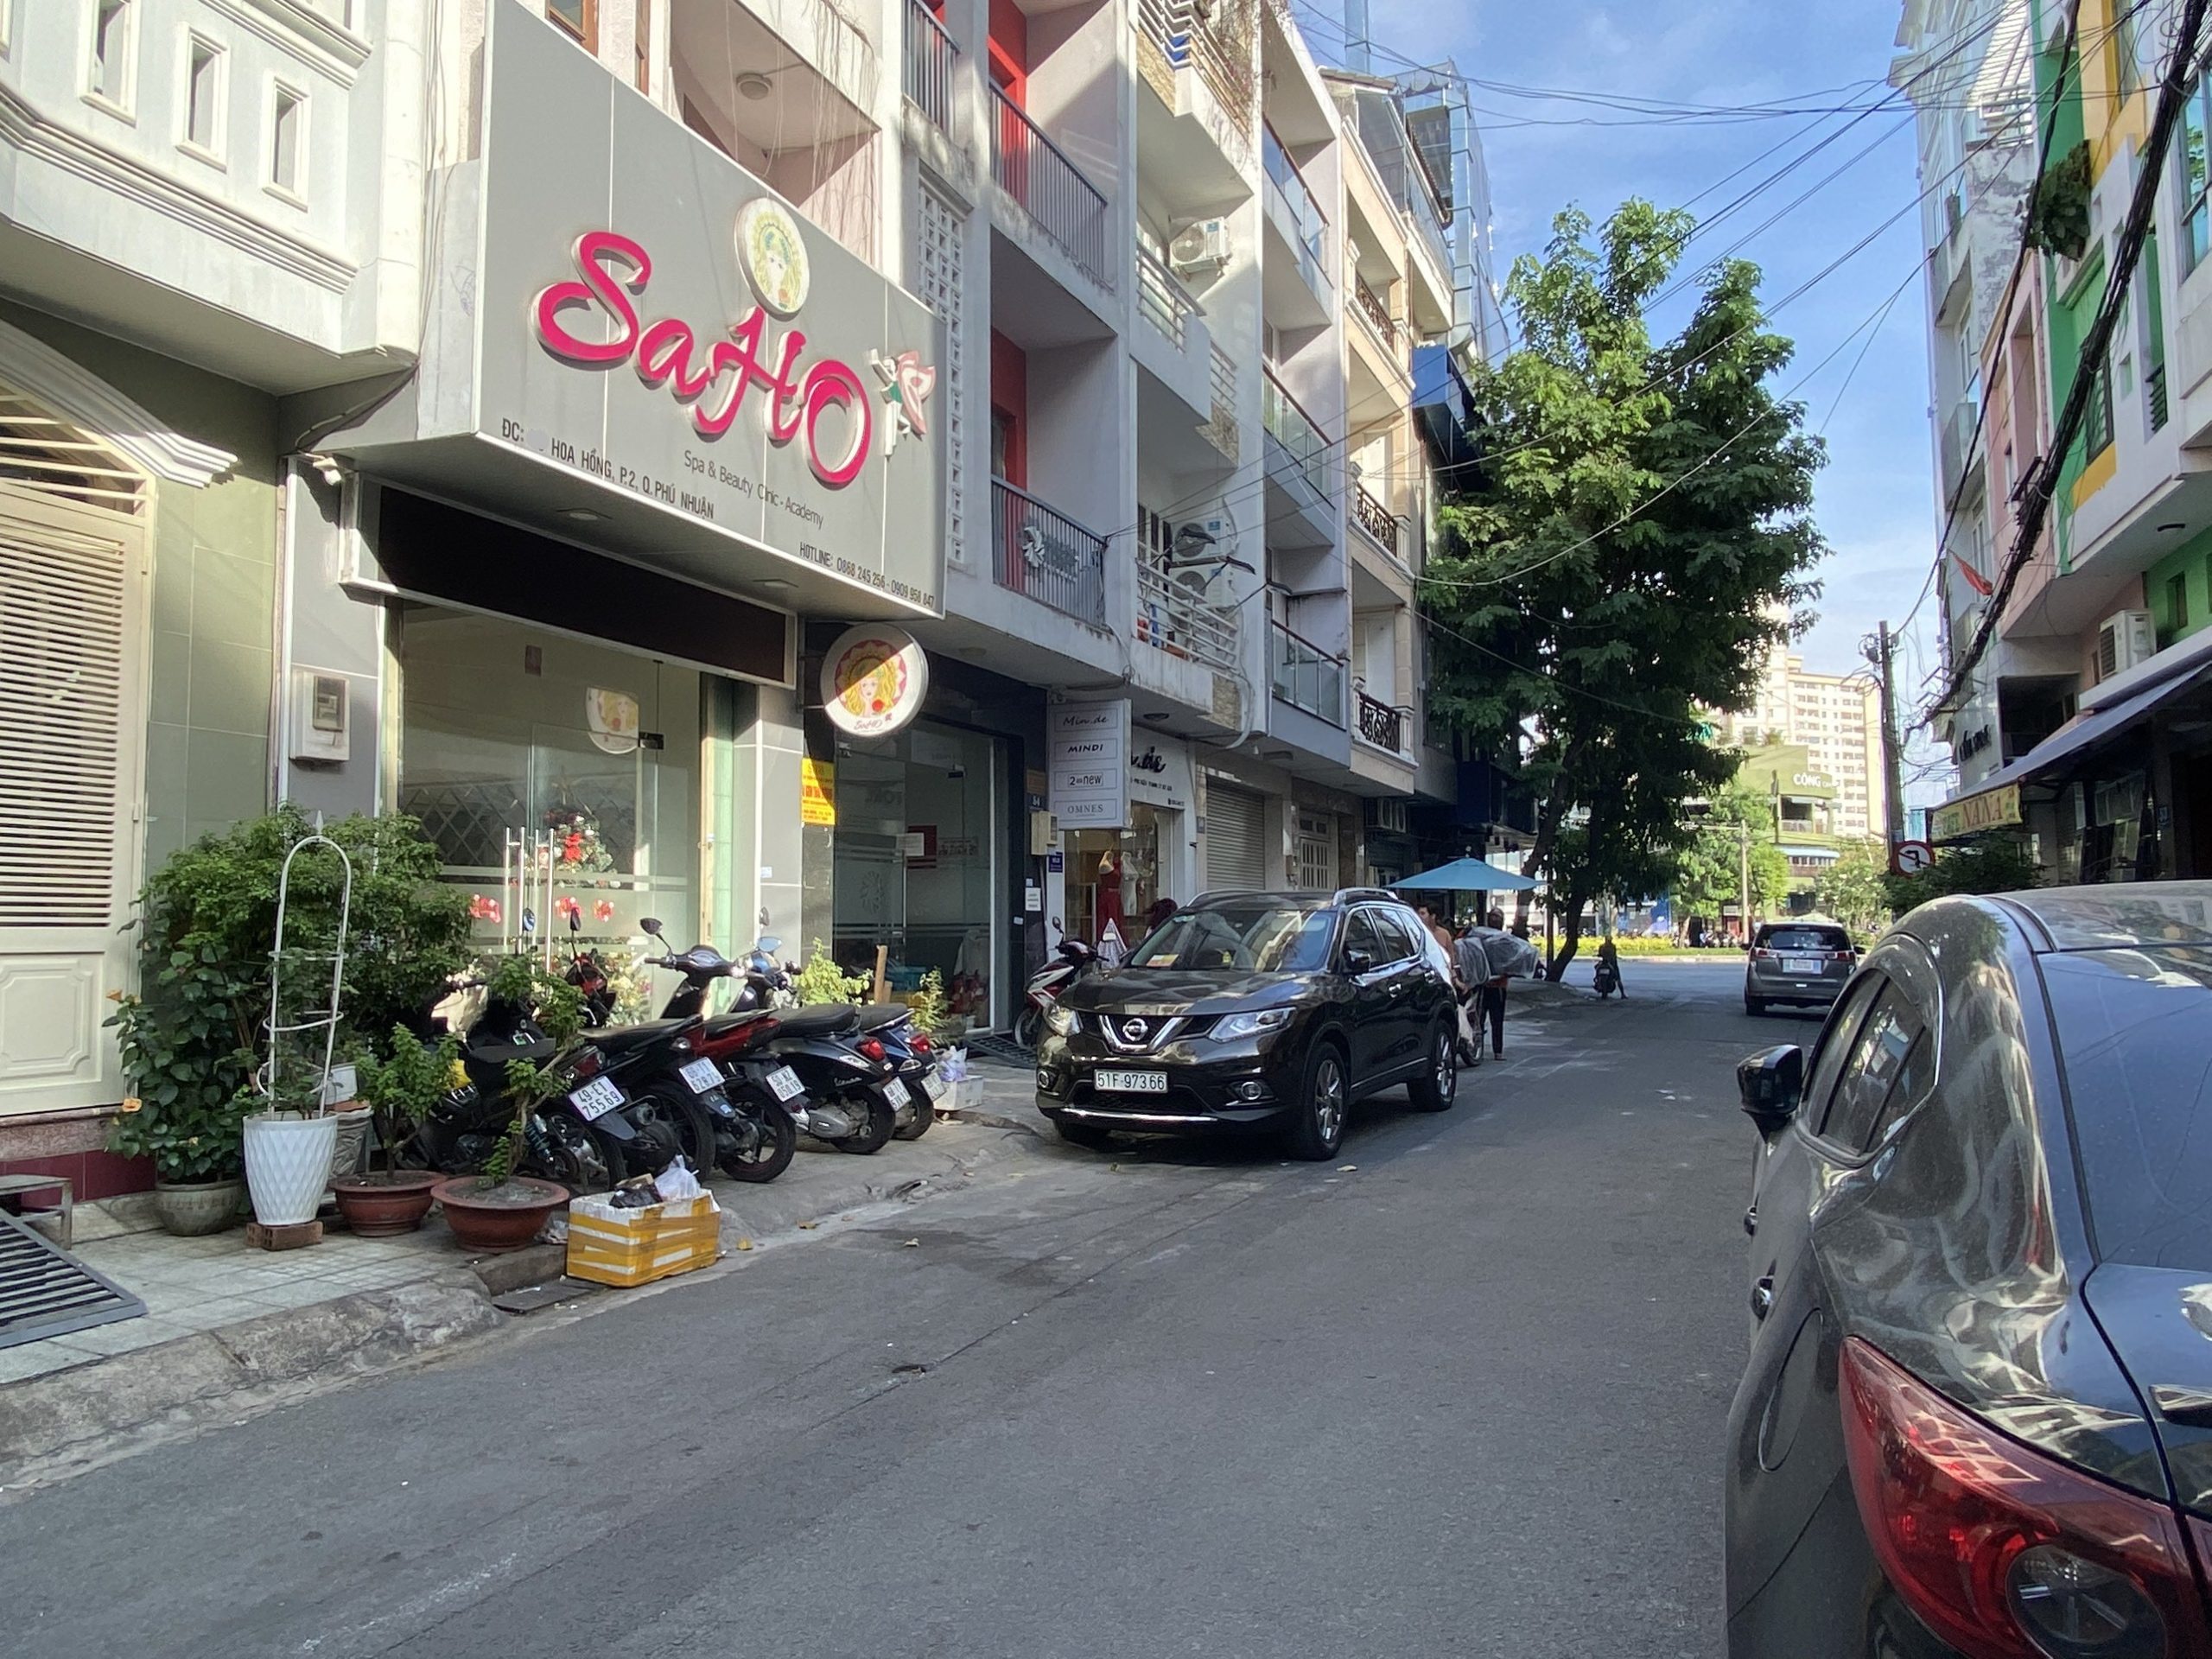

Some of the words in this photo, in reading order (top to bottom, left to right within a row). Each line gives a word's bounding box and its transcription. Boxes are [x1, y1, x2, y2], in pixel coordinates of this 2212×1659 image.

[501, 417, 524, 442] ĐC:
[551, 437, 575, 464] HOA
[582, 448, 615, 483] HỒNG,
[681, 492, 715, 520] NHUẬN
[684, 450, 704, 474] Spa
[708, 459, 716, 477] &
[720, 466, 753, 499] Beauty
[785, 497, 824, 531] Academy
[799, 542, 834, 568] HOTLINE:
[857, 565, 872, 584] 245
[1067, 743, 1104, 754] MINDI
[1067, 803, 1104, 814] OMNES
[577, 1081, 608, 1103] 49-E1
[582, 1090, 621, 1119] 755.69
